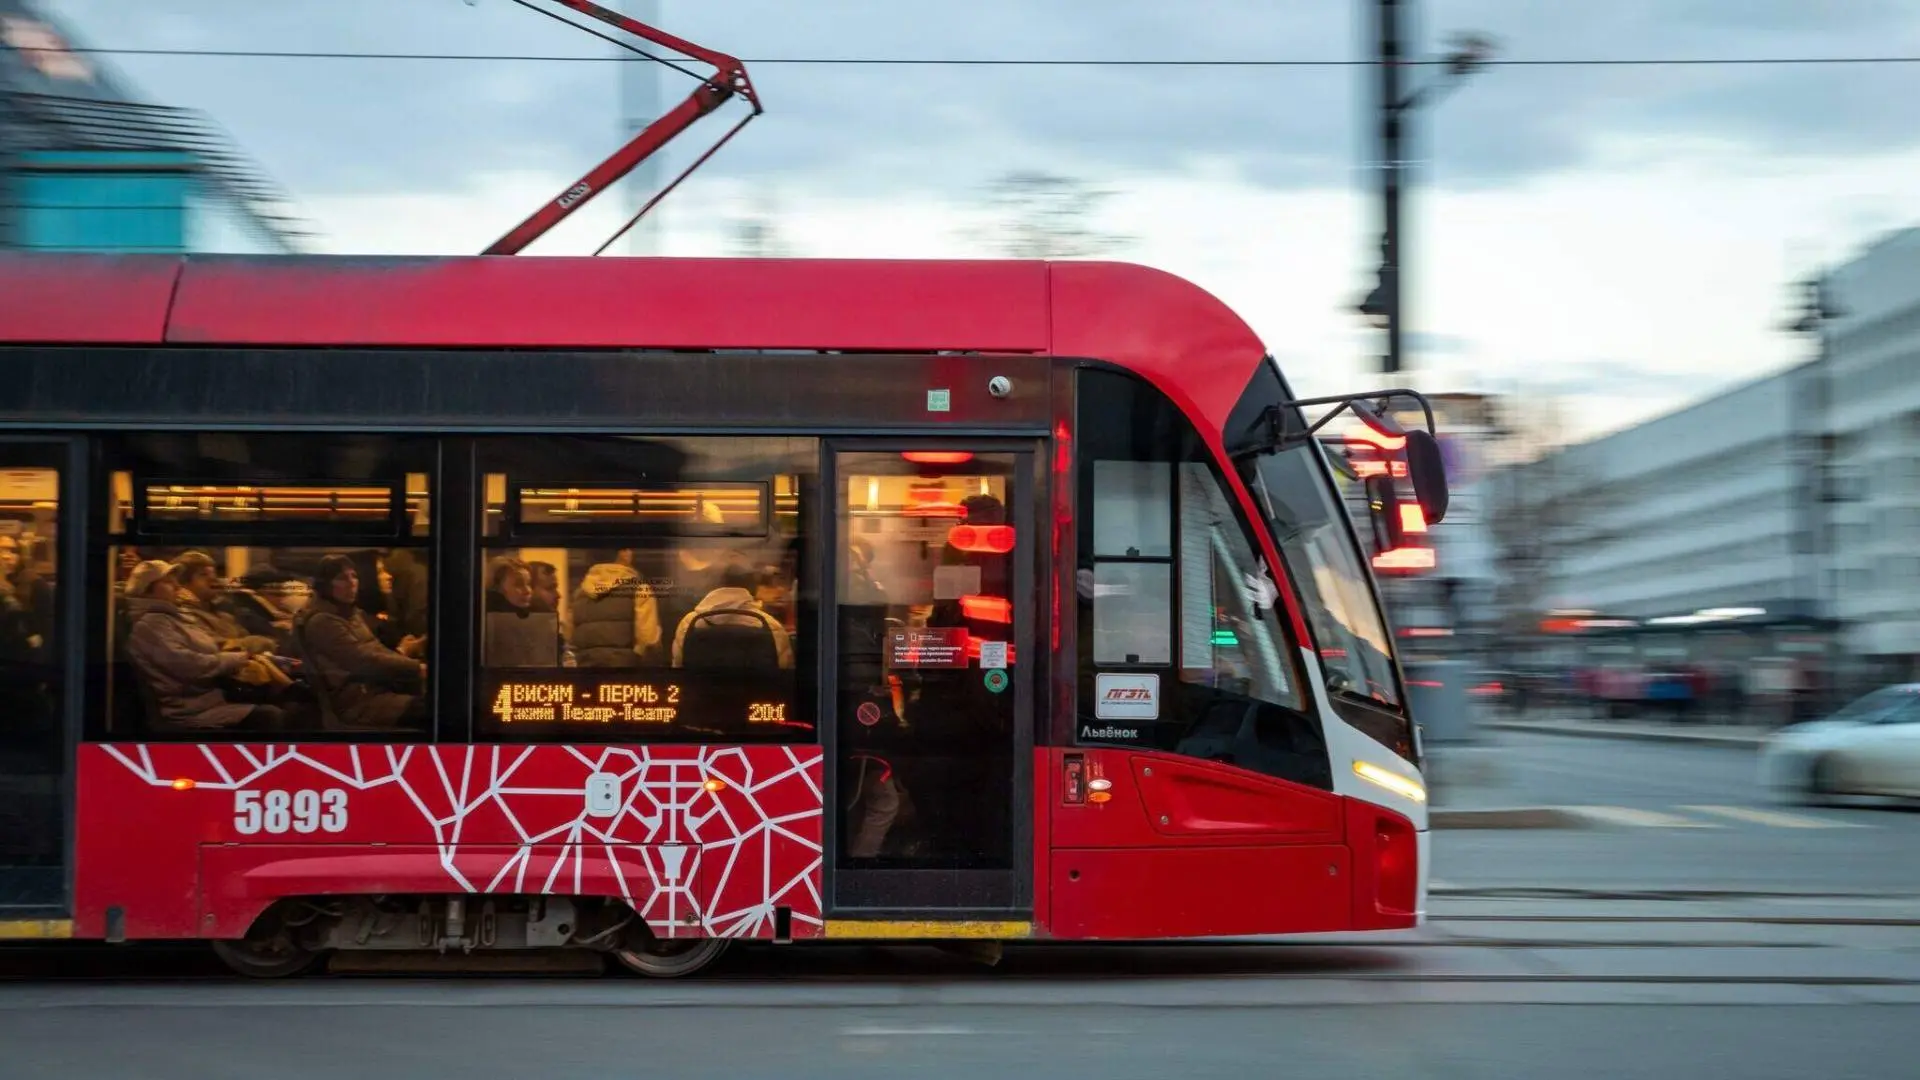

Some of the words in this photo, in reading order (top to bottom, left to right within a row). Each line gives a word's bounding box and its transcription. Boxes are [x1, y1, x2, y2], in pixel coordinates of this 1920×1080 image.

[493, 684, 513, 721] 4
[514, 685, 573, 702] ВИСИМ
[600, 685, 658, 702] ПЕРМЬ
[668, 685, 679, 702] 2
[562, 703, 676, 722] Театр-Театр
[1081, 725, 1138, 738] Львёнок
[234, 788, 348, 834] 5893
